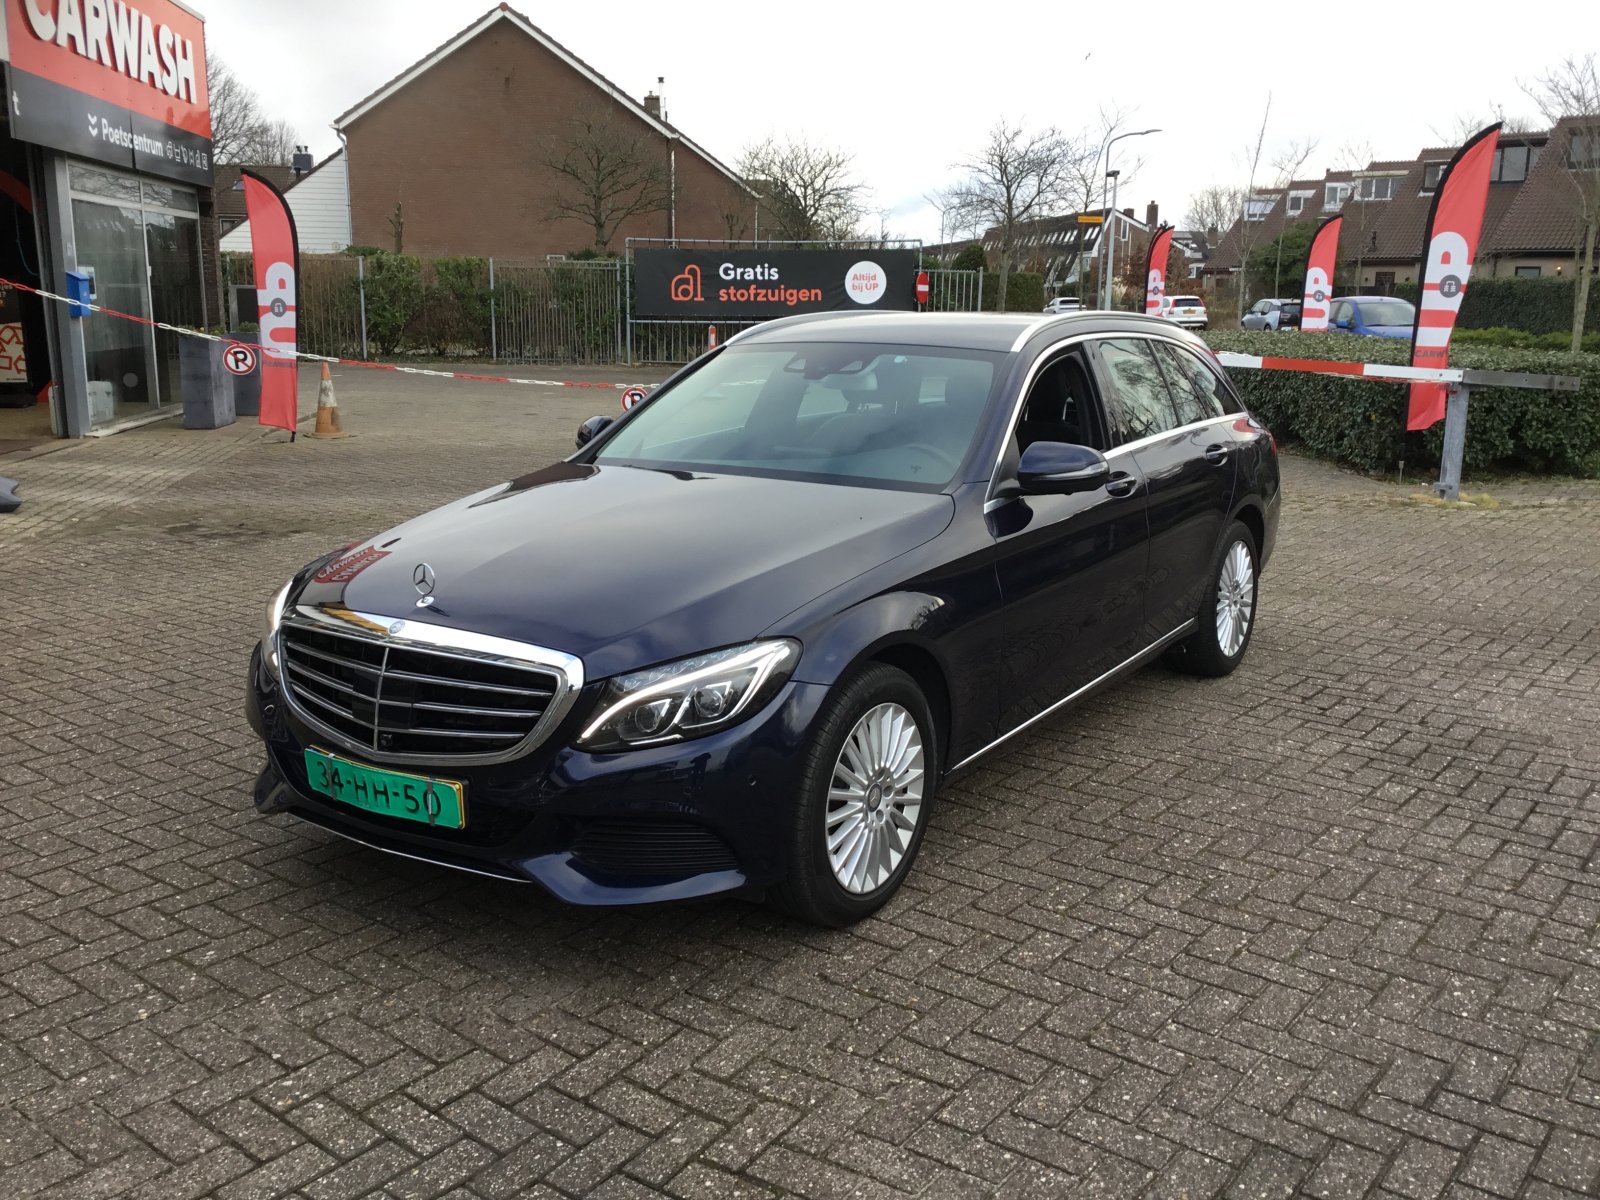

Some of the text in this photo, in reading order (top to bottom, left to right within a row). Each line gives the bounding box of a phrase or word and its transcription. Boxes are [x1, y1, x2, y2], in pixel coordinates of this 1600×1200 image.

[25, 0, 197, 104] CARWASH
[101, 118, 164, 157] Poetscentrum
[719, 262, 779, 280] Gratis
[852, 273, 877, 282] Altijd
[719, 284, 822, 306] stofzuigen
[852, 283, 863, 292] bij
[317, 761, 441, 817] 34-HH-50
